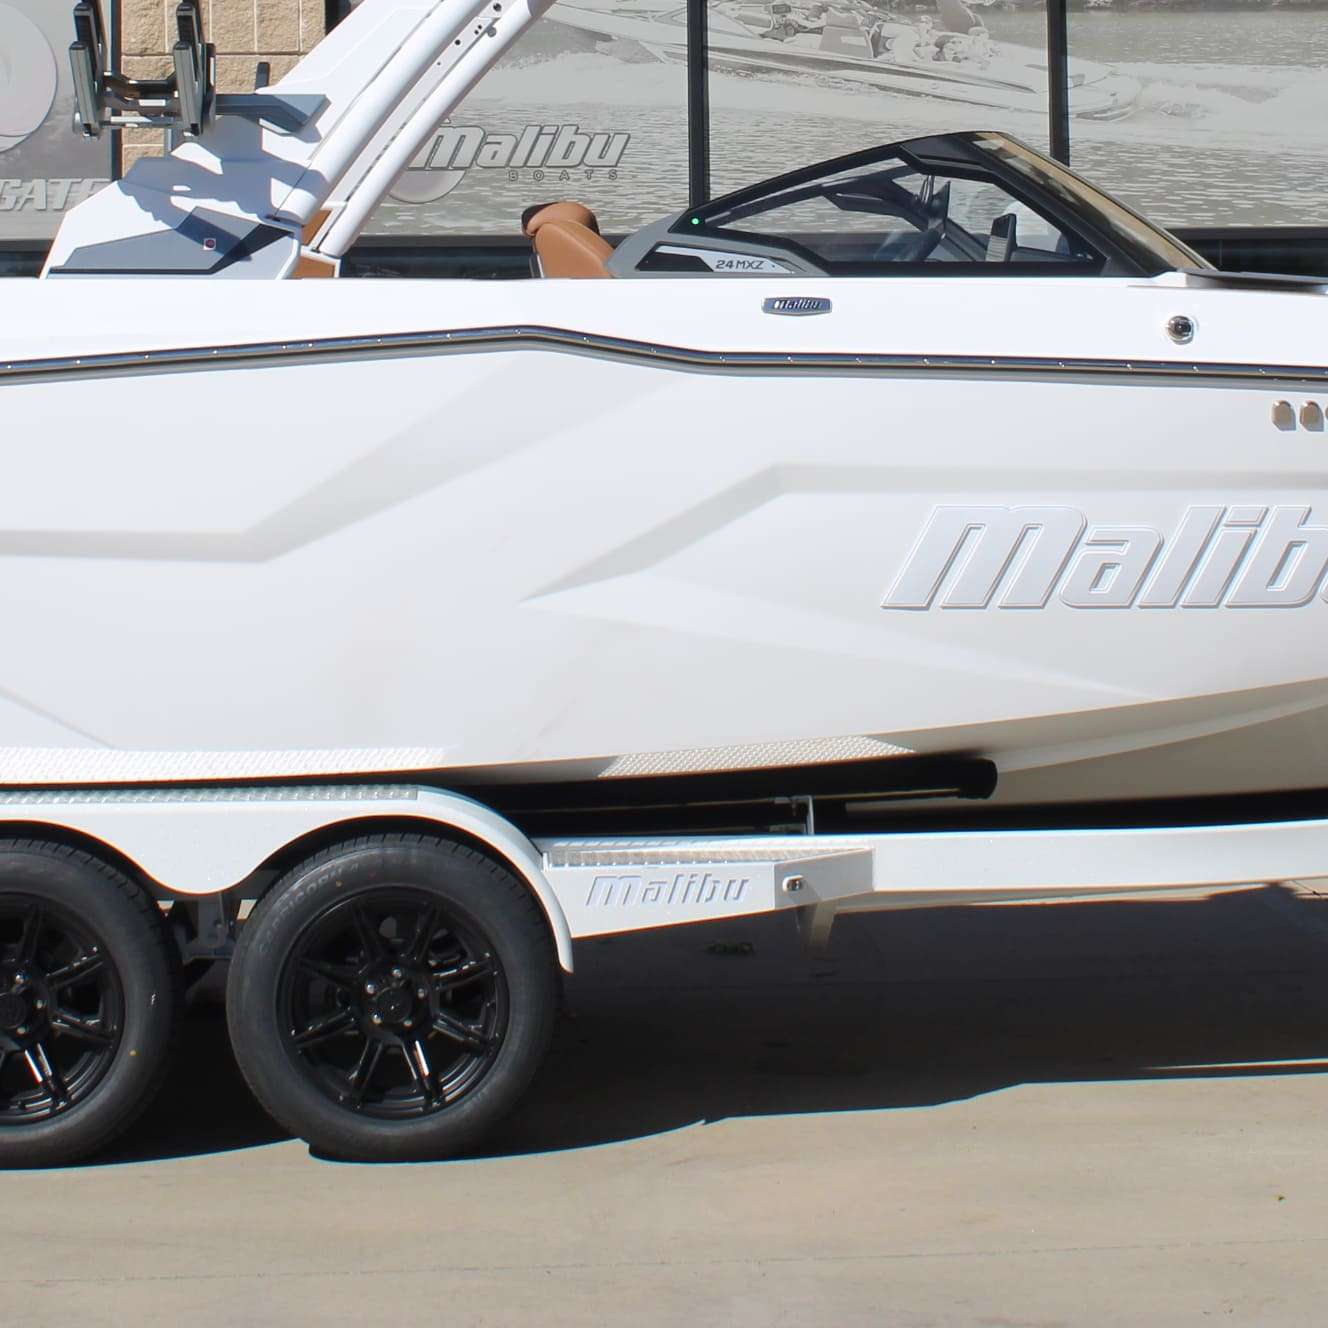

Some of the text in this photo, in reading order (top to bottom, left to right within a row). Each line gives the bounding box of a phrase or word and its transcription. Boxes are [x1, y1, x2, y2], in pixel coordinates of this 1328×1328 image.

[407, 123, 631, 171] Malibu
[508, 168, 618, 182] BOATS
[585, 872, 751, 907] Malibu
